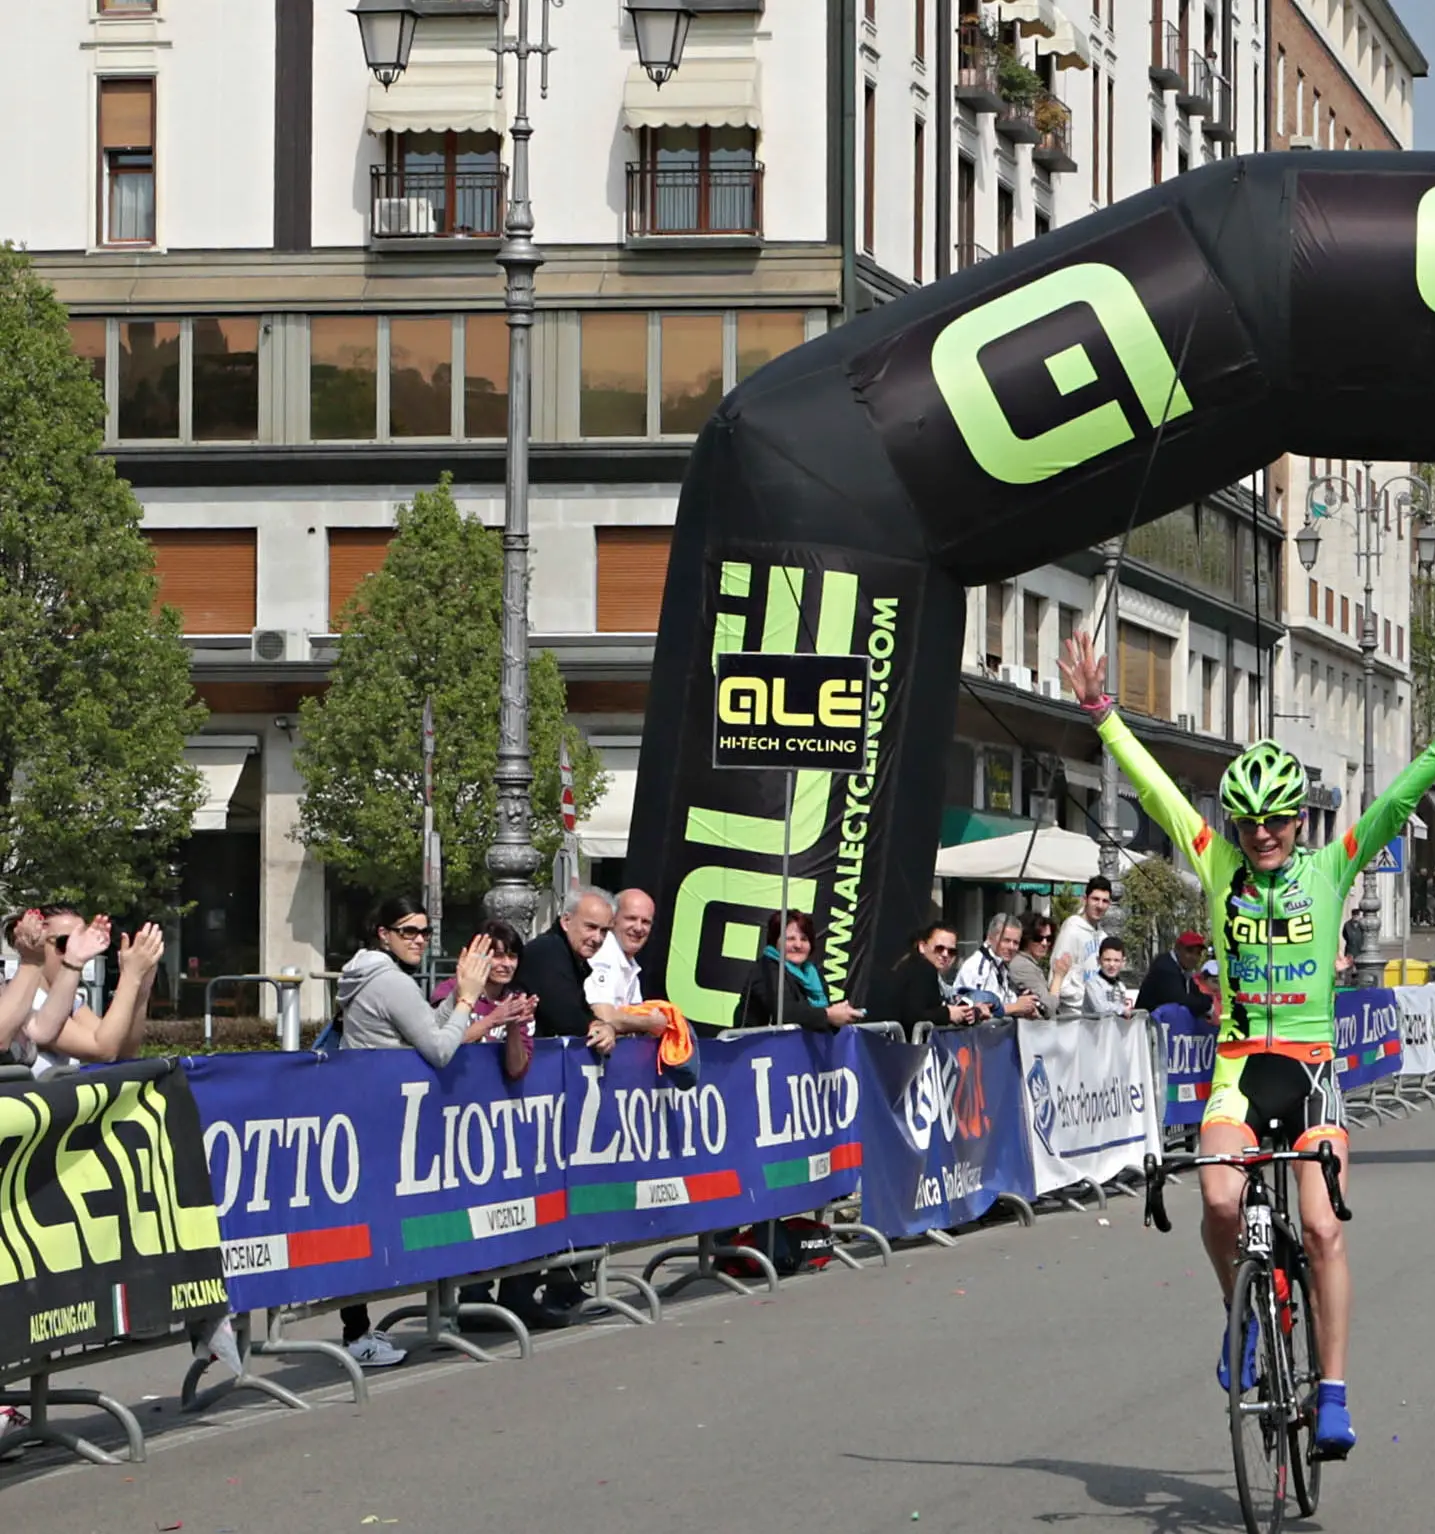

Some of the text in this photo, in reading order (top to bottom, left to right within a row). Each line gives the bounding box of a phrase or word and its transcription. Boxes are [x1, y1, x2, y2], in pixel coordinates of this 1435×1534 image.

[720, 736, 858, 754] HI-TECH CYCLING
[569, 1064, 727, 1166] LIOTTO
[30, 1300, 97, 1344] ALECYCLING.COM
